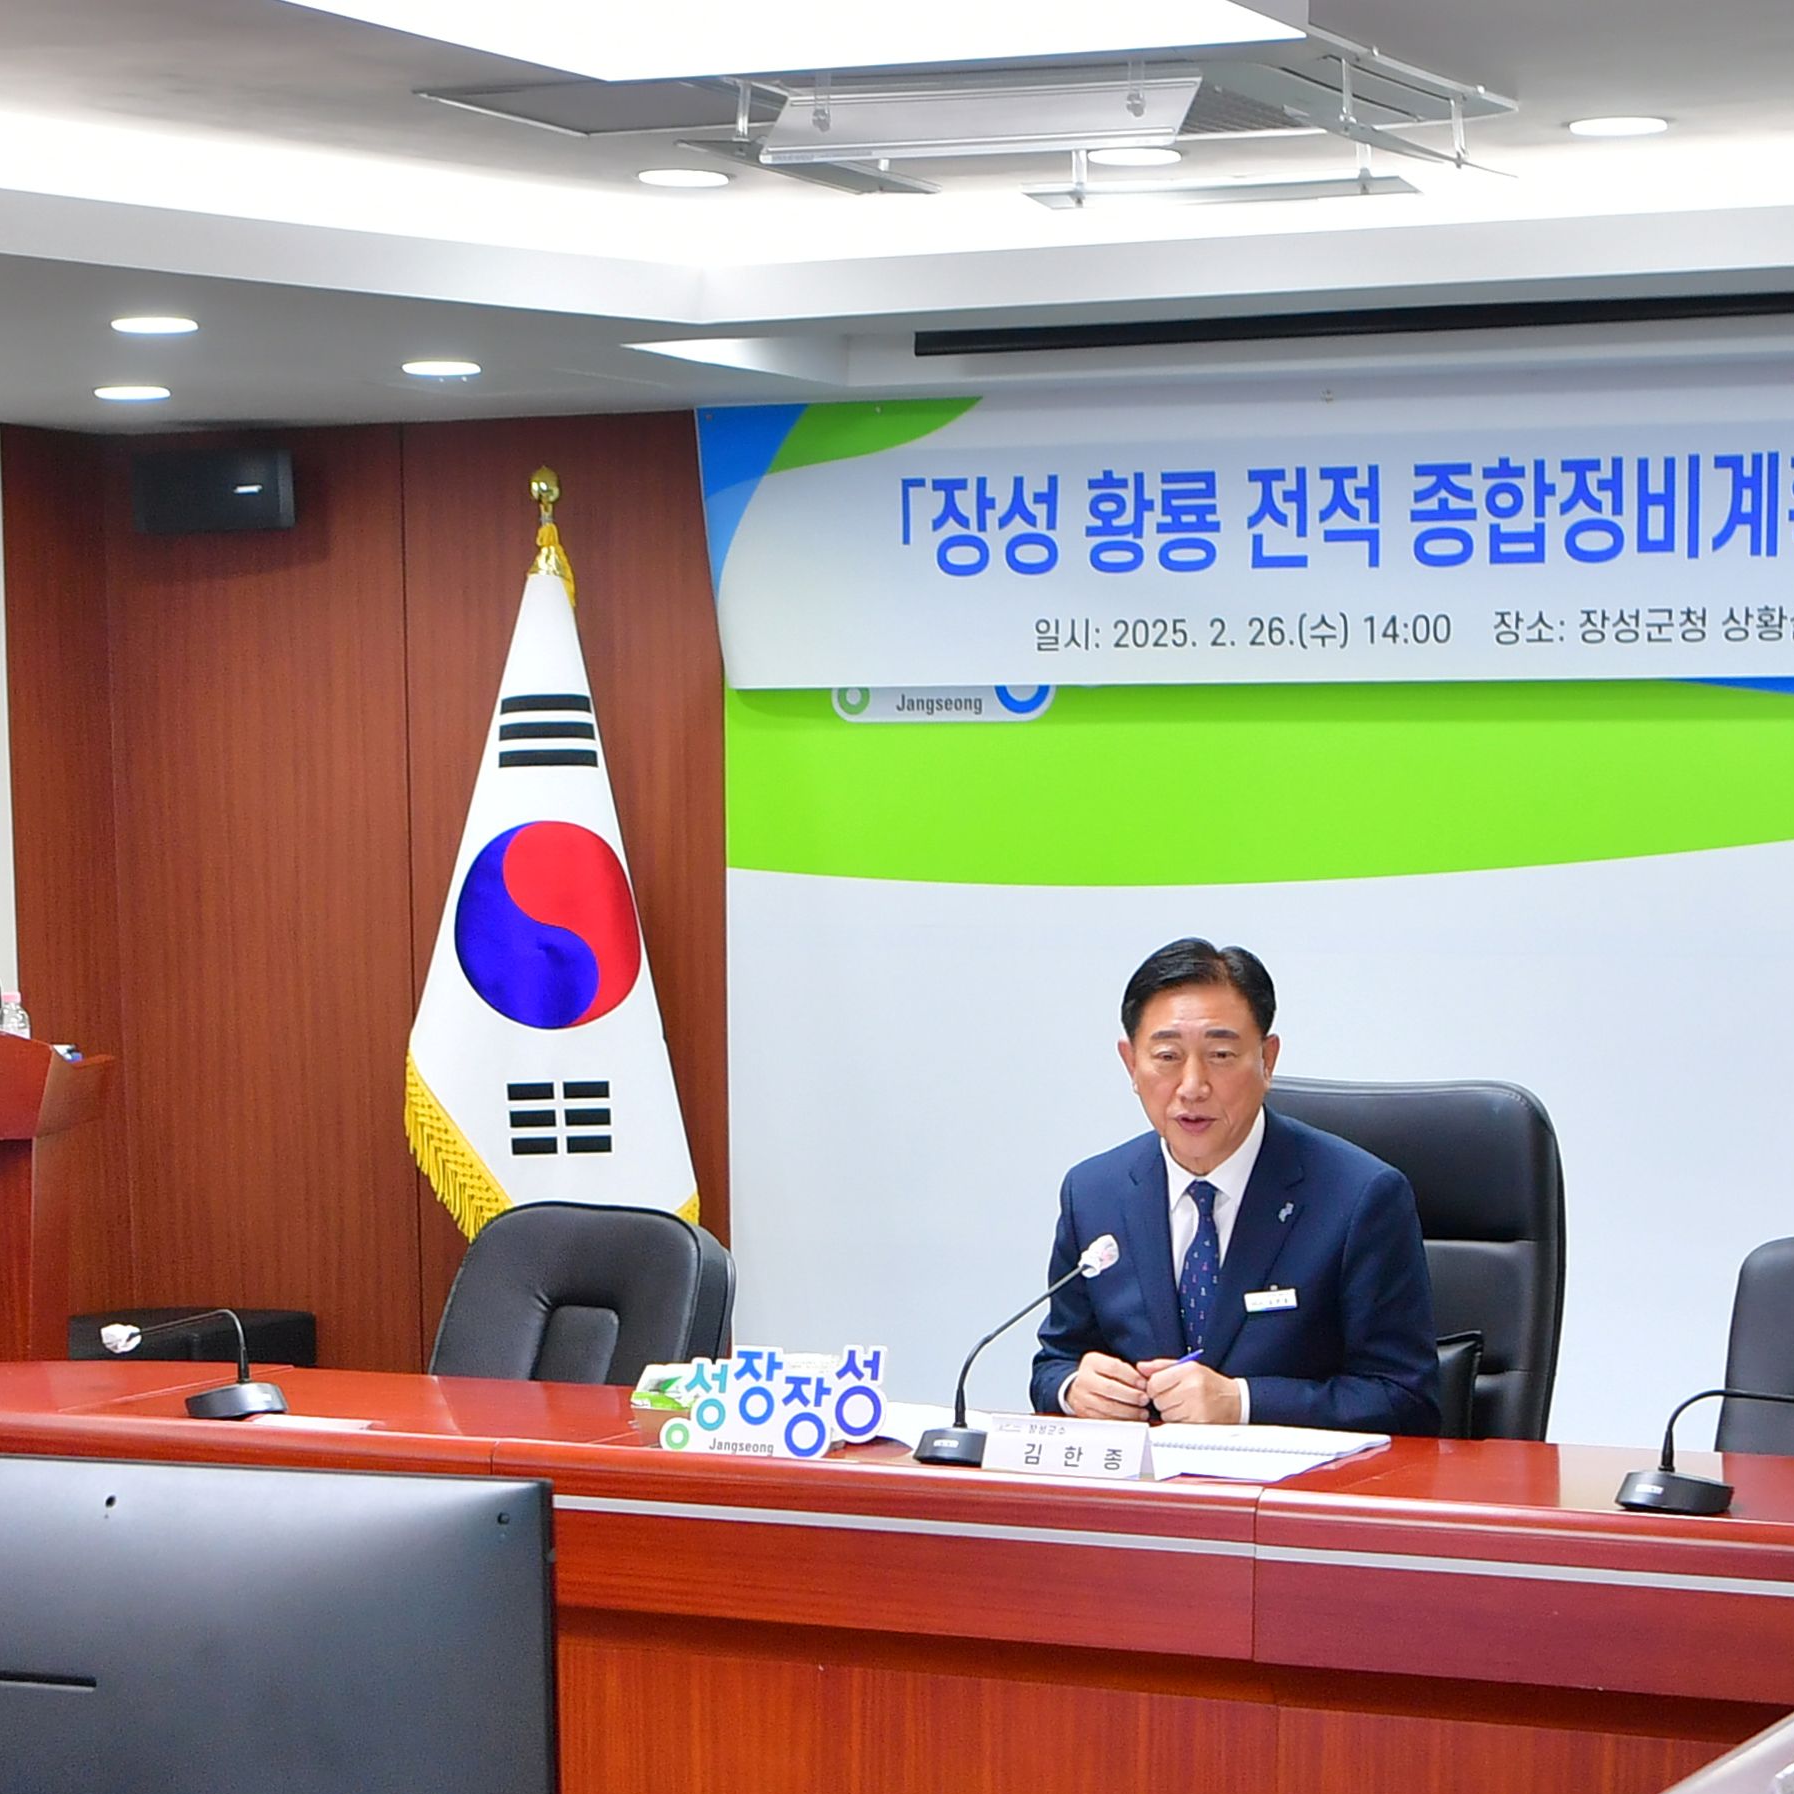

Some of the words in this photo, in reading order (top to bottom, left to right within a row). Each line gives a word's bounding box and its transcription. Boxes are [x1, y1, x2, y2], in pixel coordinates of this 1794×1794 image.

[900, 473, 1060, 577] 「장성
[1084, 469, 1221, 573] 황룡
[1247, 463, 1381, 569] 전적
[1035, 617, 1101, 652] 일시:
[1112, 618, 1197, 648] 2025.
[1209, 618, 1235, 647] 2.
[1248, 611, 1349, 648] 26.(수)
[1363, 613, 1452, 645] 14:00
[1493, 610, 1565, 646] 장소:
[1578, 608, 1707, 645] 장성군청
[896, 693, 983, 715] Jangseong
[709, 1437, 774, 1457] Jangseong
